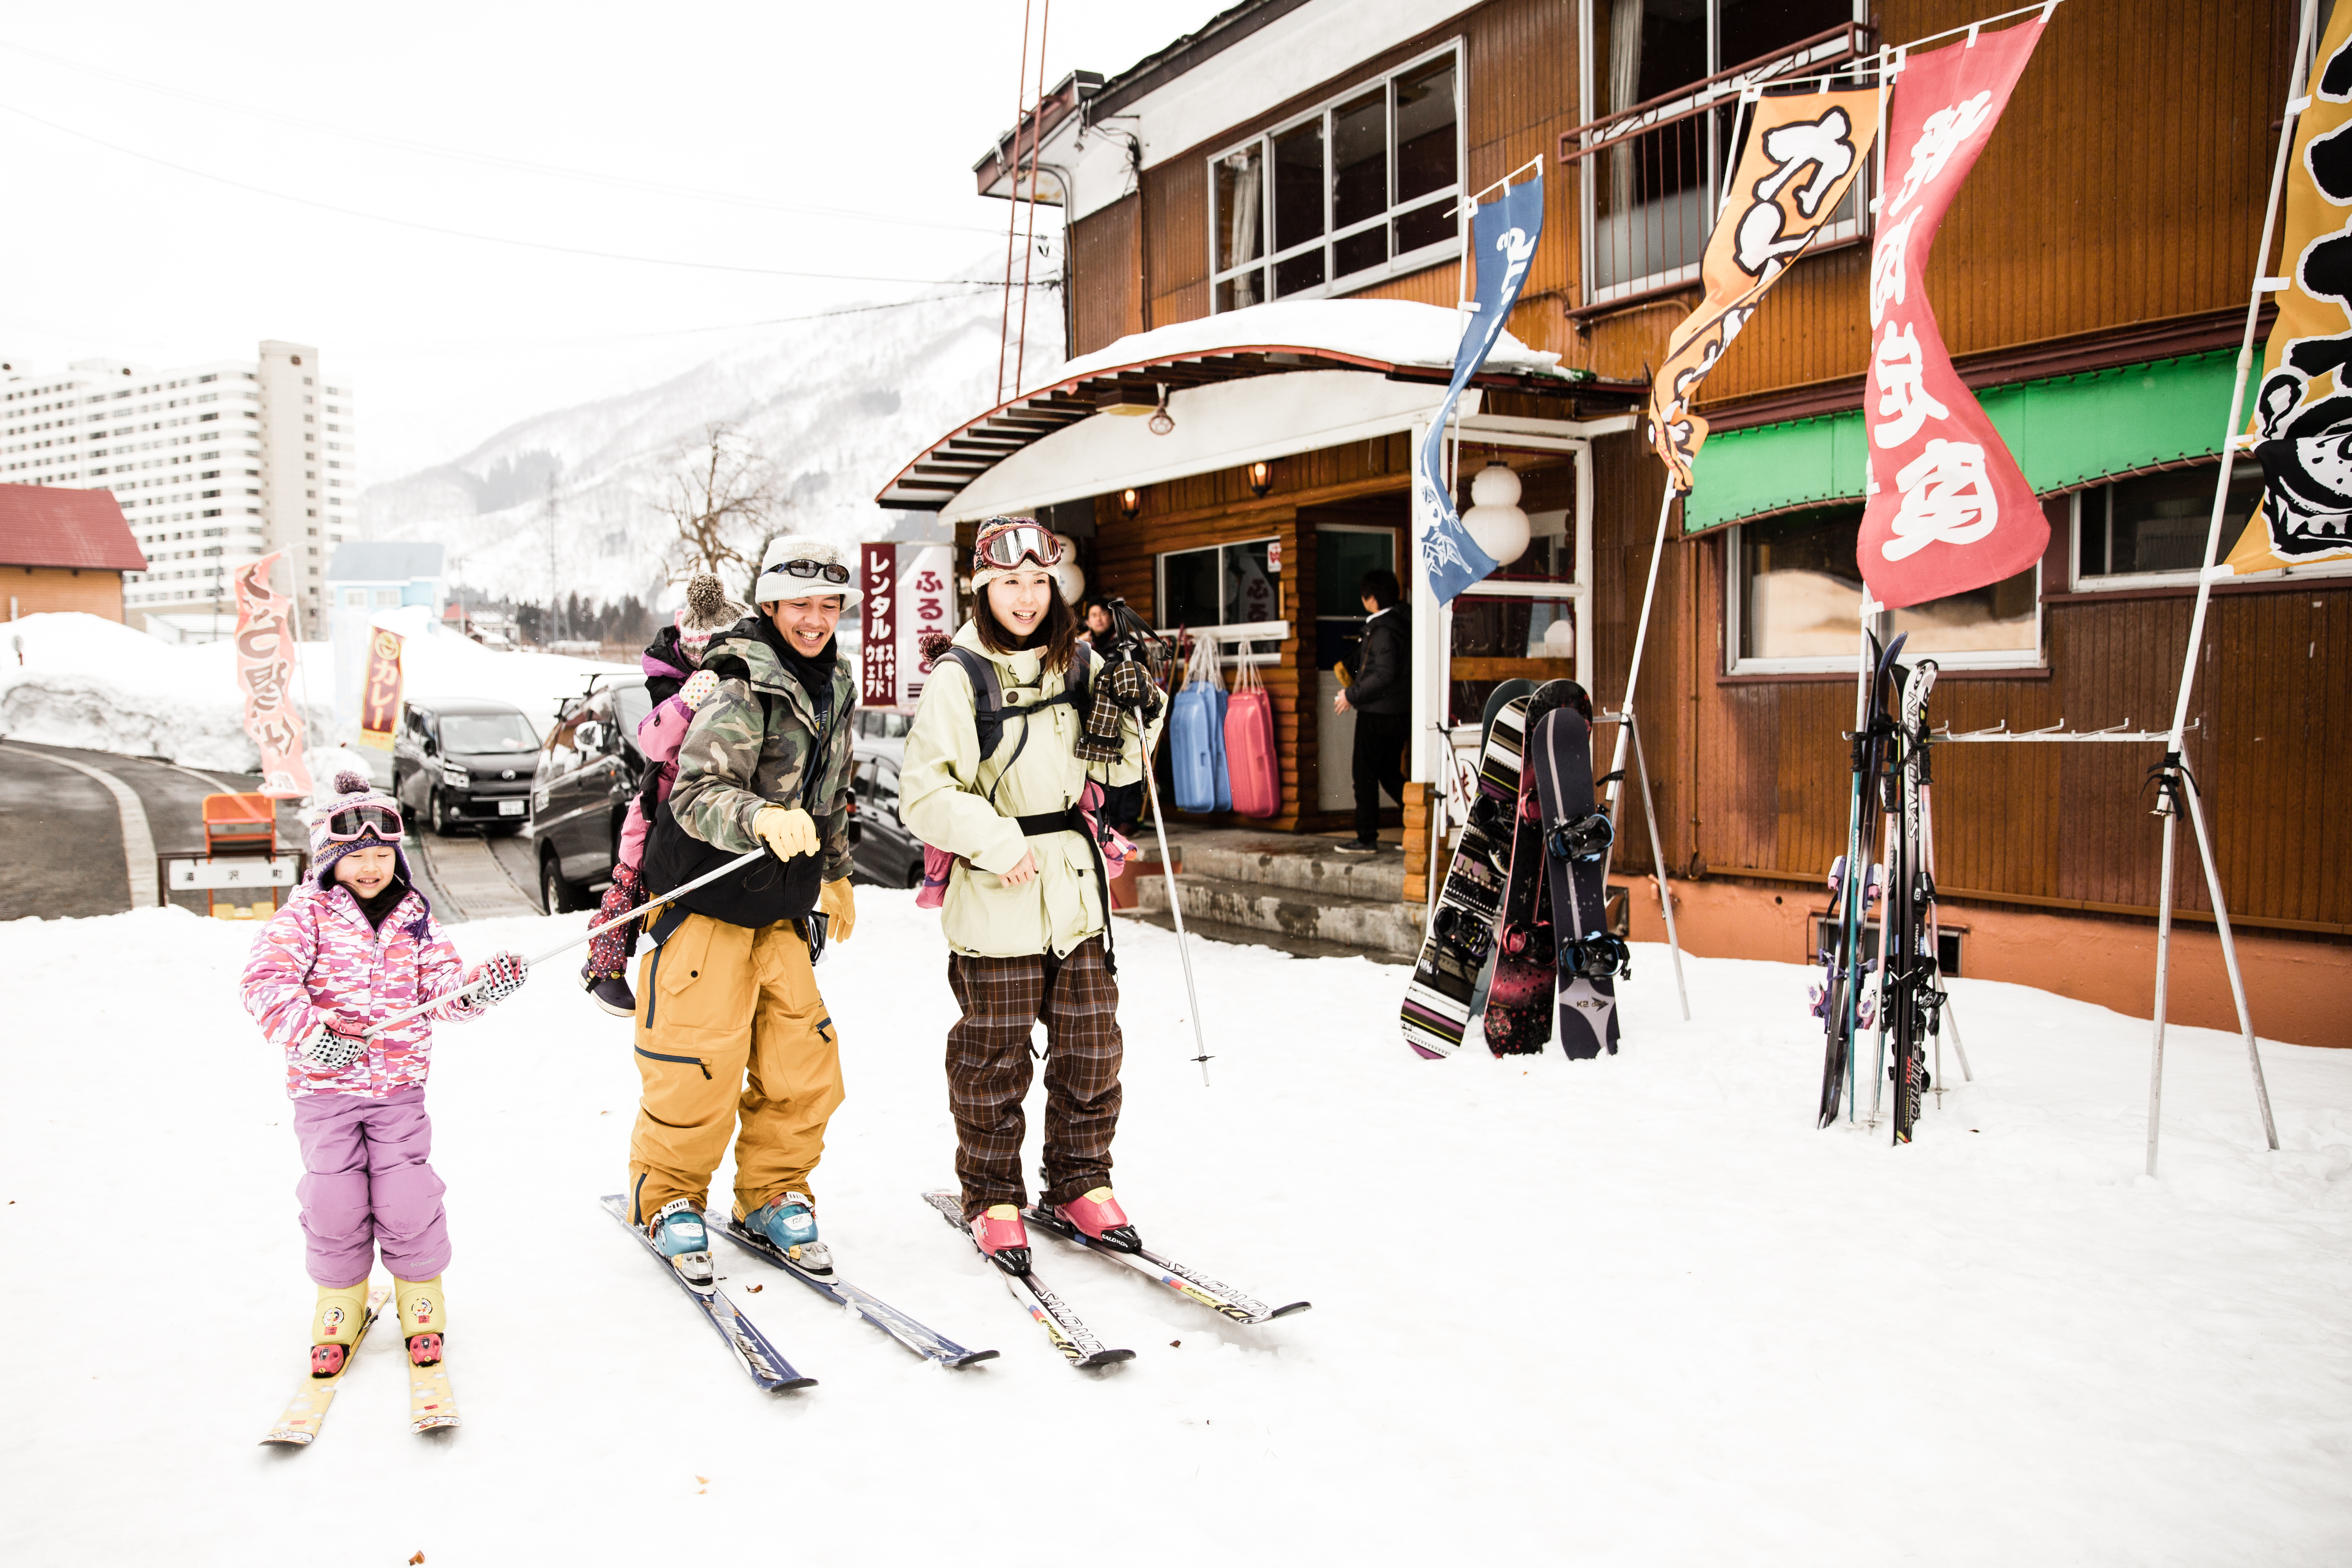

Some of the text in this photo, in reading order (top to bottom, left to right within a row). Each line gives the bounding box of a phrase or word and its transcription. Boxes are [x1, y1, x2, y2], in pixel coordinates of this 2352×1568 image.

[870, 551, 892, 640] レンタル
[371, 659, 398, 730] カレー
[865, 644, 876, 698] ウェア
[876, 644, 885, 698] ボード
[885, 644, 895, 697] スキー
[1907, 692, 1919, 841] SALOON
[995, 1253, 1015, 1270] SALOMON
[1101, 1234, 1128, 1248] SALOMON
